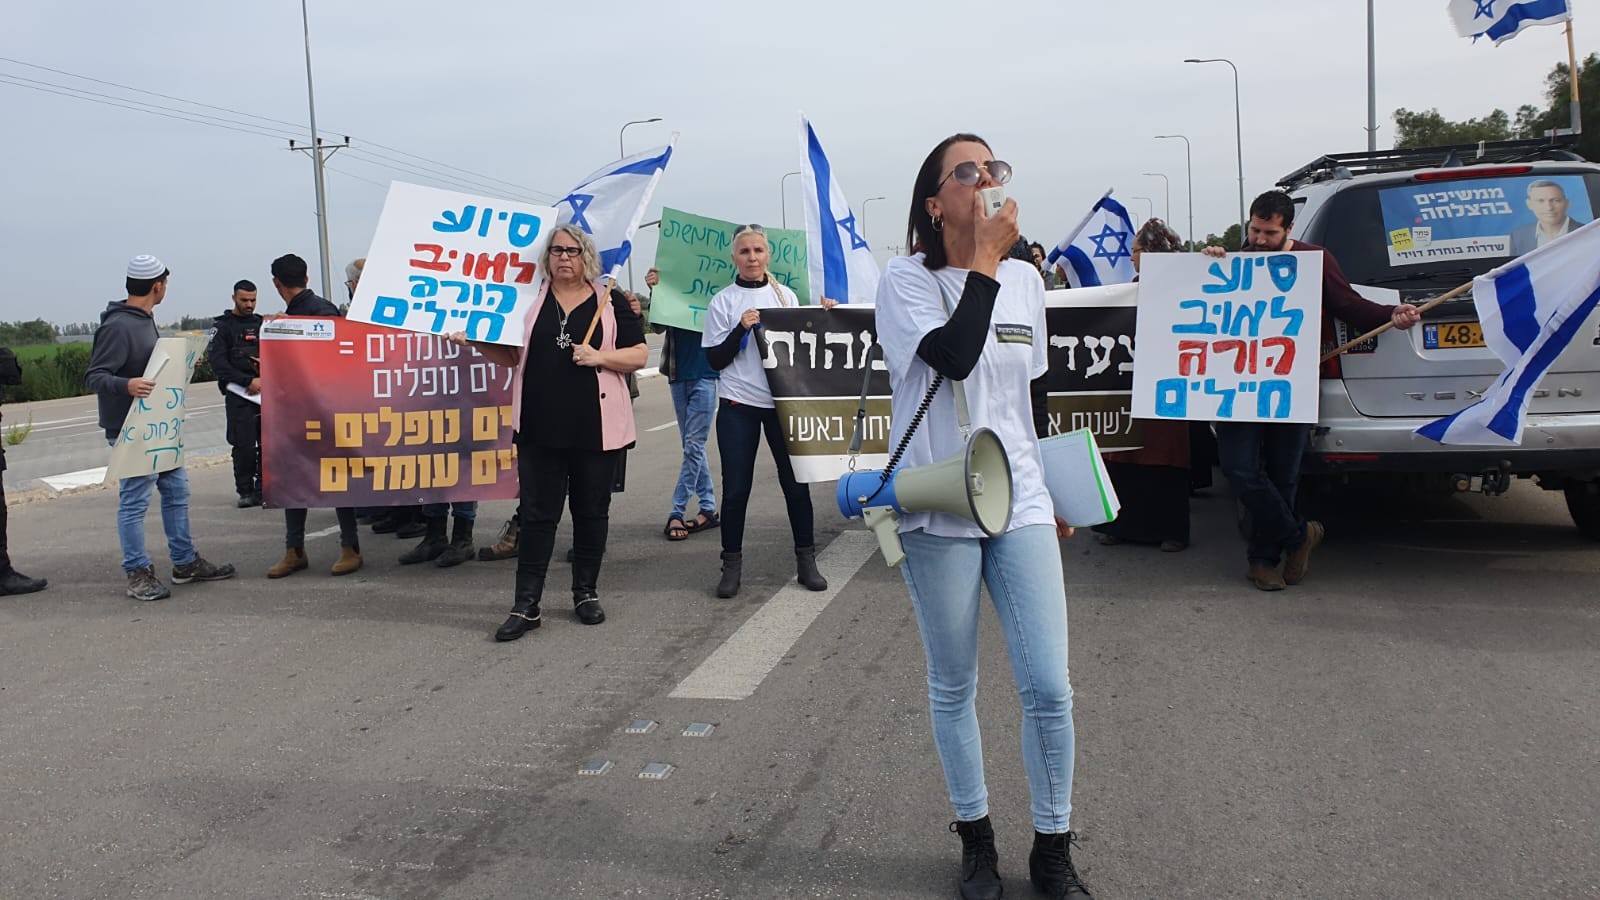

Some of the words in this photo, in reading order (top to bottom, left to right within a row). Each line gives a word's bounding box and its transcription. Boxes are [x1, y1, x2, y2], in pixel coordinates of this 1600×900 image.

[1413, 187, 1505, 205] ממשיכים
[432, 205, 542, 247] סיוע
[1396, 250, 1424, 260] דוידי
[1428, 246, 1463, 257] בוחרת
[1467, 243, 1505, 253] שדרות
[1201, 254, 1298, 294] סיוע
[370, 295, 506, 342] חיילים
[761, 329, 888, 371] מהות
[1049, 335, 1135, 379] צעד
[373, 364, 460, 399] נופלים
[1154, 378, 1293, 419] חיילים
[334, 406, 462, 448] נופלים
[788, 414, 845, 442] באש!
[320, 453, 460, 493] עומדים
